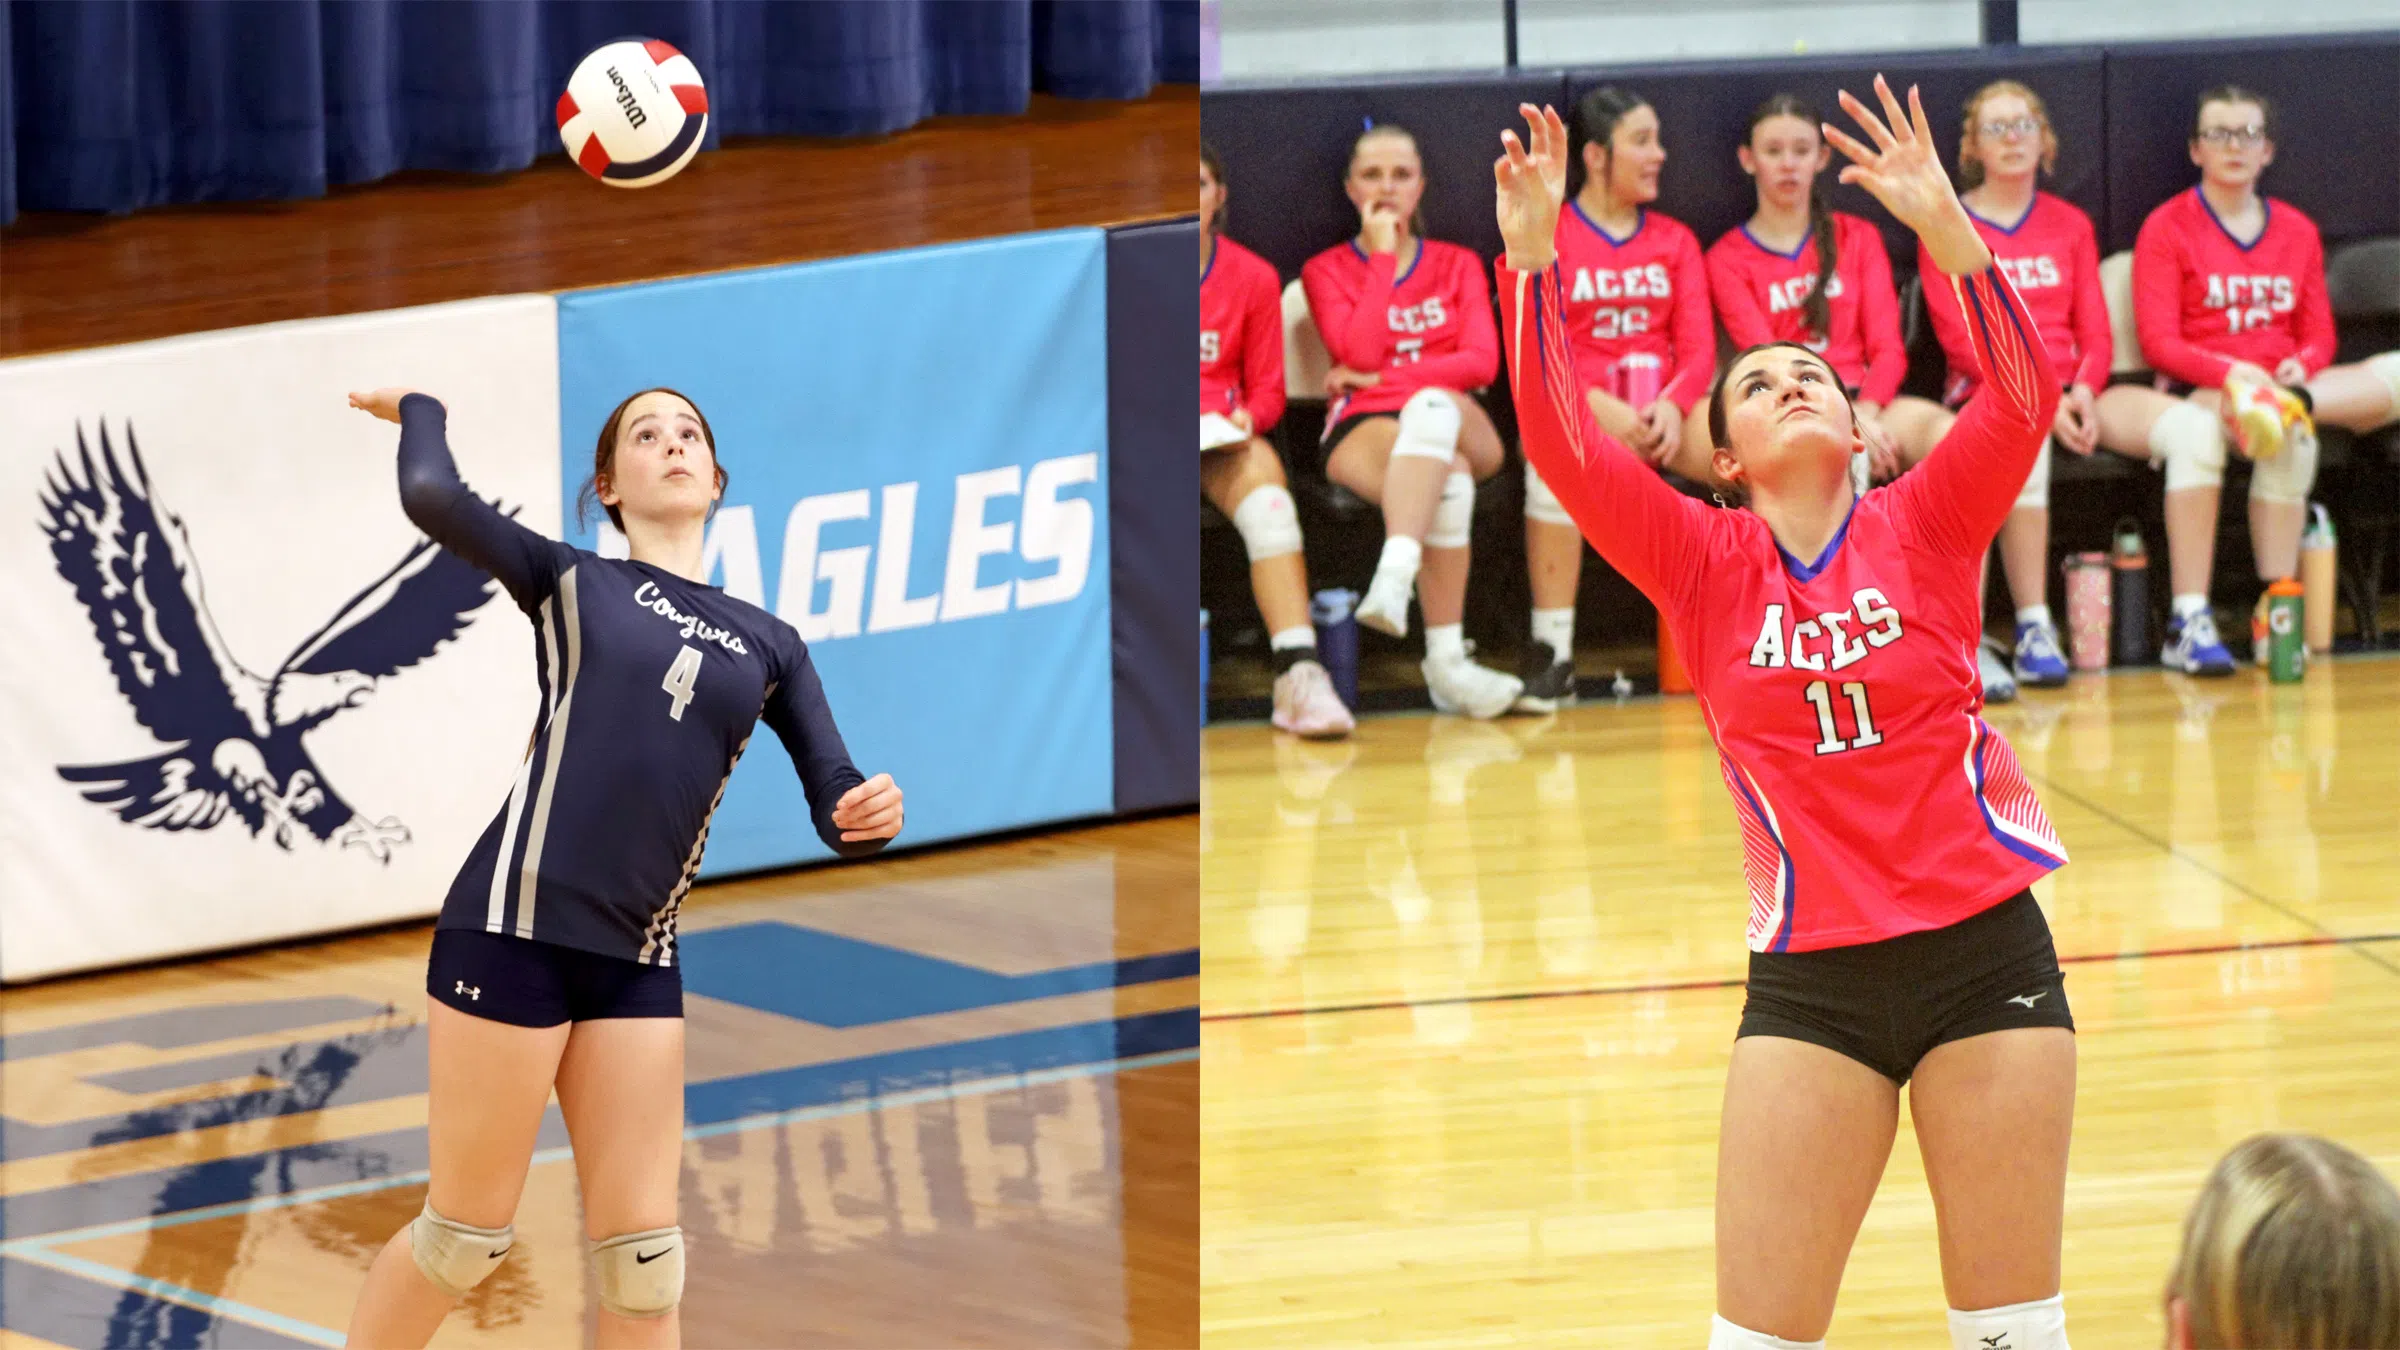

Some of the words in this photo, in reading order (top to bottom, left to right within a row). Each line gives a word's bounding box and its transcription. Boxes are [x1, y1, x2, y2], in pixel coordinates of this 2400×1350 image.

[606, 66, 647, 130] Wilson
[1571, 263, 1671, 303] ACES
[1999, 256, 2060, 289] CES
[2203, 273, 2296, 313] ACES
[1388, 295, 1447, 334] CES
[597, 452, 1098, 643] AGLES
[634, 580, 748, 655] Cougars
[1748, 587, 1904, 672] ACES
[661, 643, 704, 722] 4
[1804, 680, 1884, 756] 11
